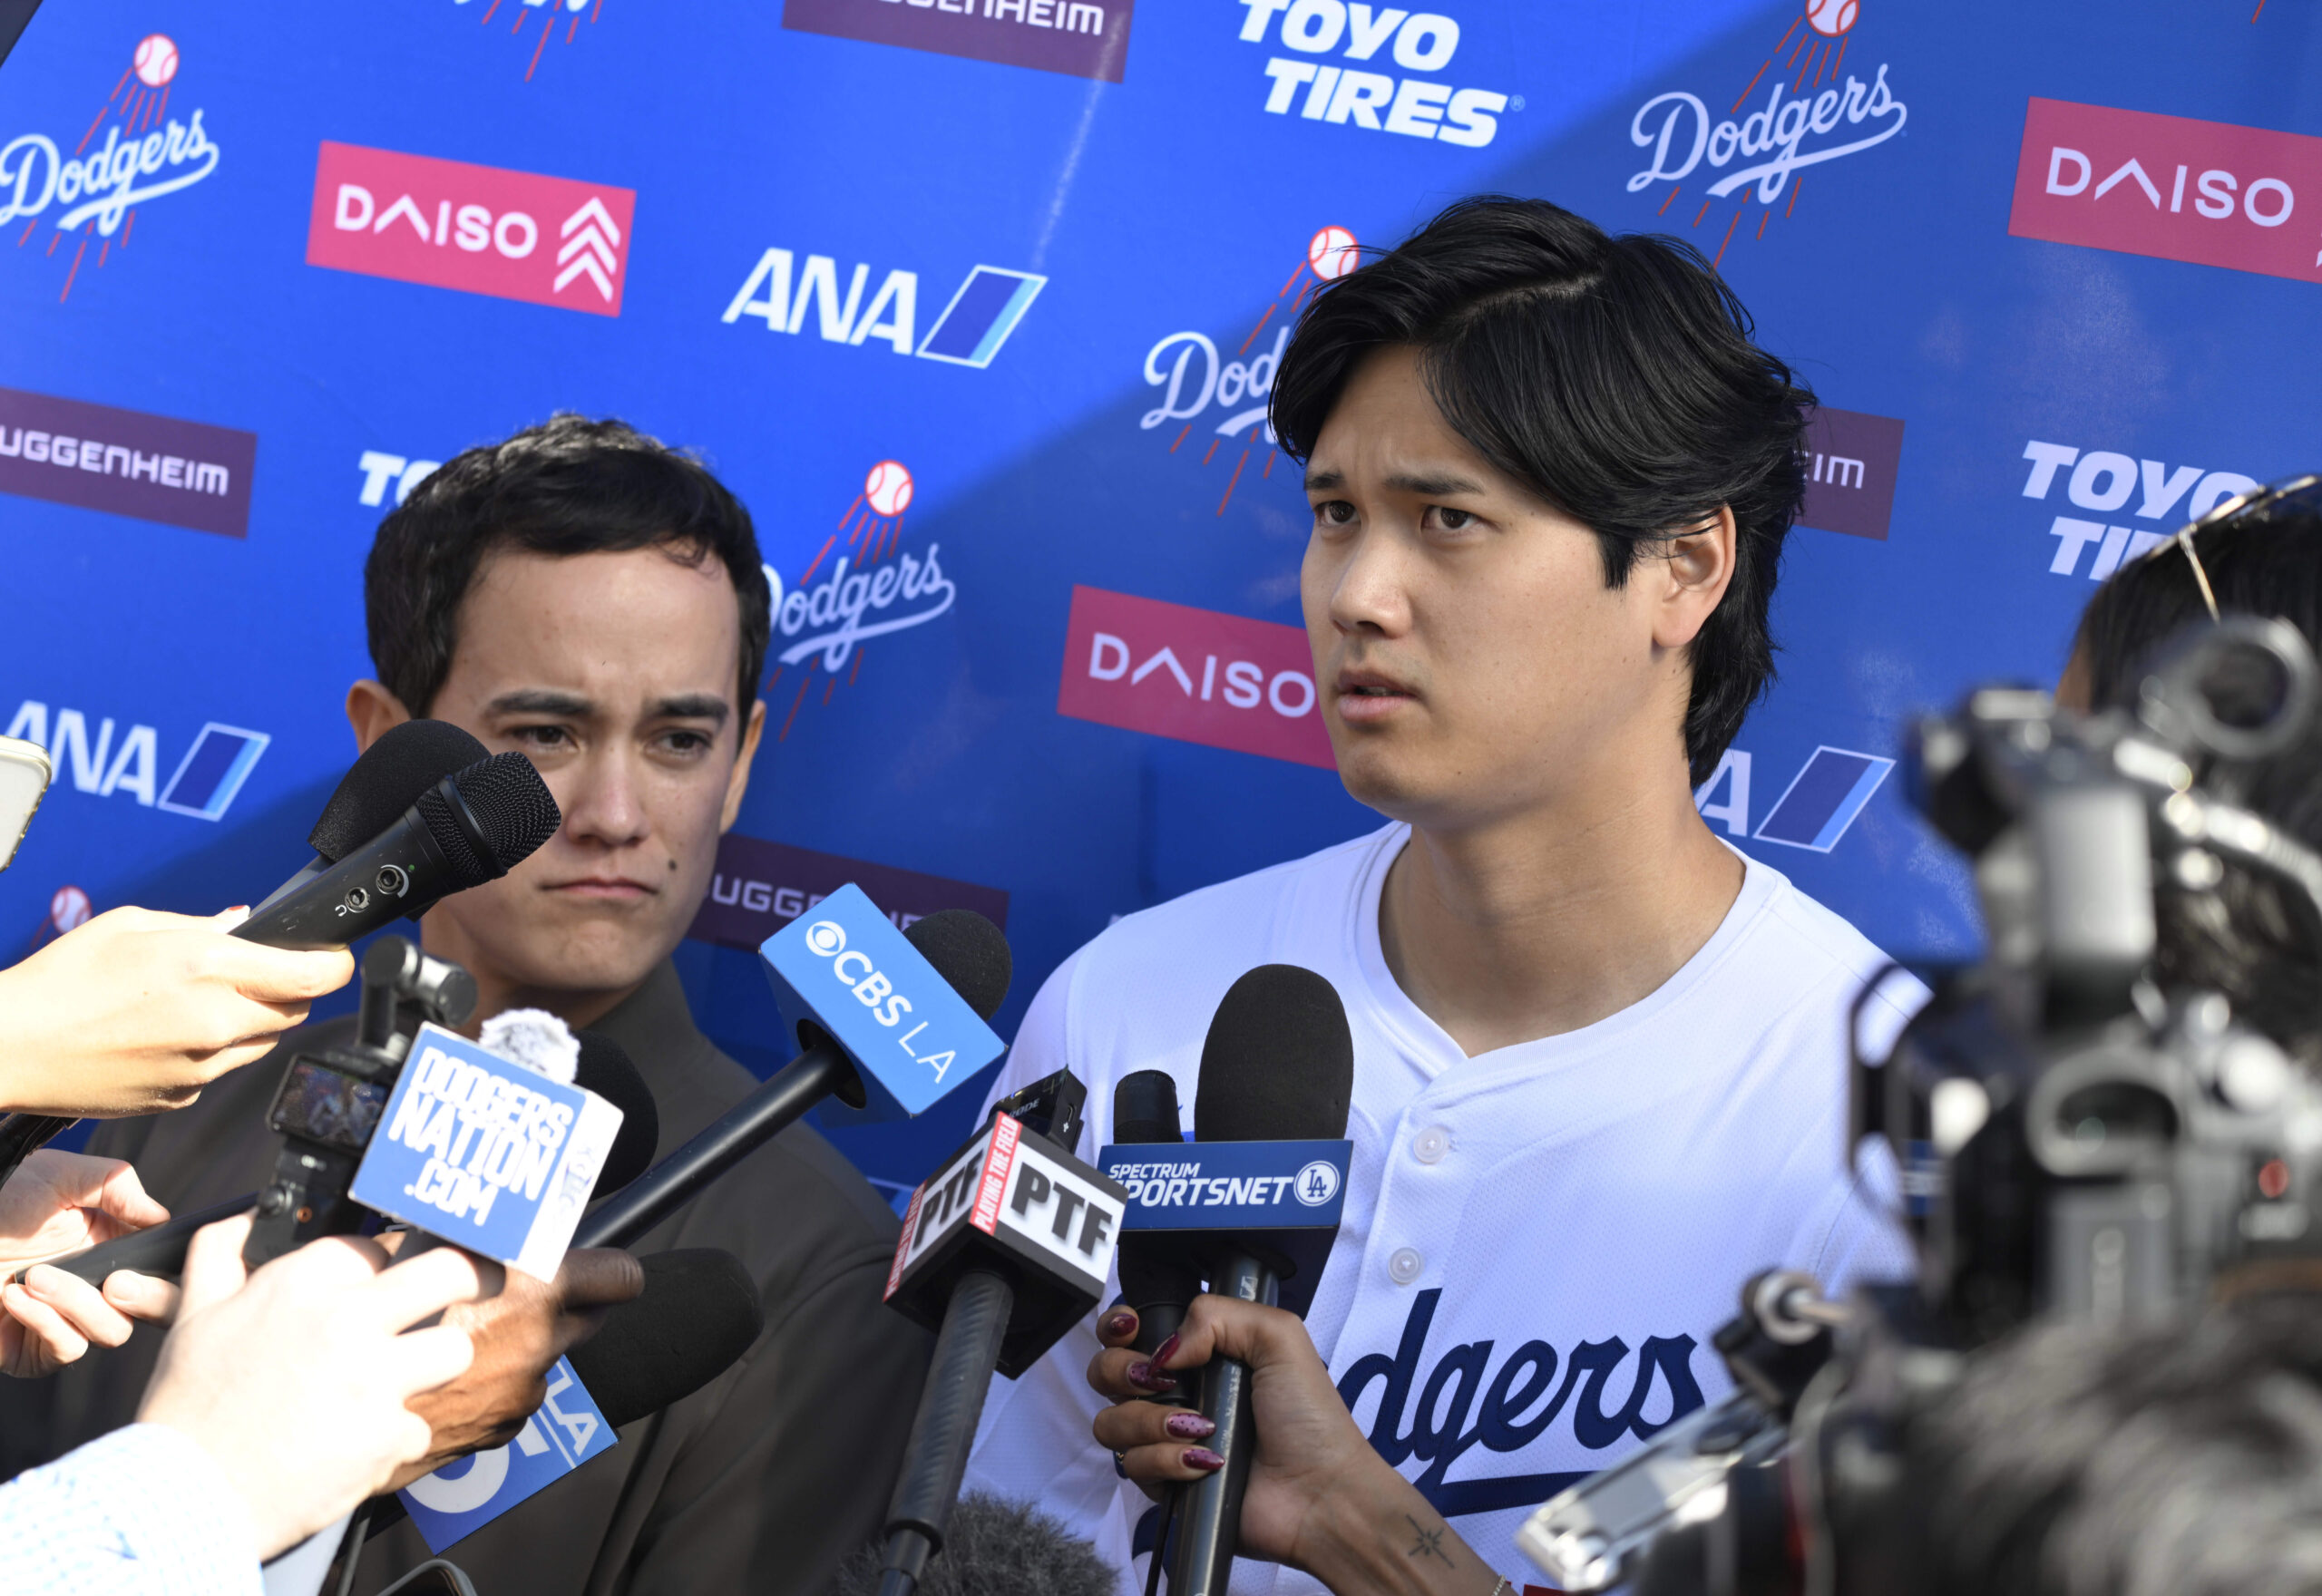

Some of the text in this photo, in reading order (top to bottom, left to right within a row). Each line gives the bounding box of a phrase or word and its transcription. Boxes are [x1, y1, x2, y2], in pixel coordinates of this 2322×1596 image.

[1239, 0, 1459, 72] TOYO
[0, 107, 220, 237] Dodgers
[1626, 63, 1907, 204] Dodgers
[334, 183, 538, 258] DAISO
[2045, 146, 2294, 227] DAISO
[722, 247, 917, 355] ANA
[762, 542, 955, 673] odgers
[1089, 632, 1314, 717] DAISO
[834, 950, 956, 1084] CBS LA
[387, 1086, 557, 1202] NATION
[410, 1046, 574, 1150] DODGERS
[404, 1158, 500, 1226] .COM
[912, 1149, 984, 1251] PTF
[974, 1115, 1019, 1231] PLAYING THE FIELD
[1010, 1162, 1113, 1256] PTF
[1108, 1163, 1201, 1179] SPECTRUM
